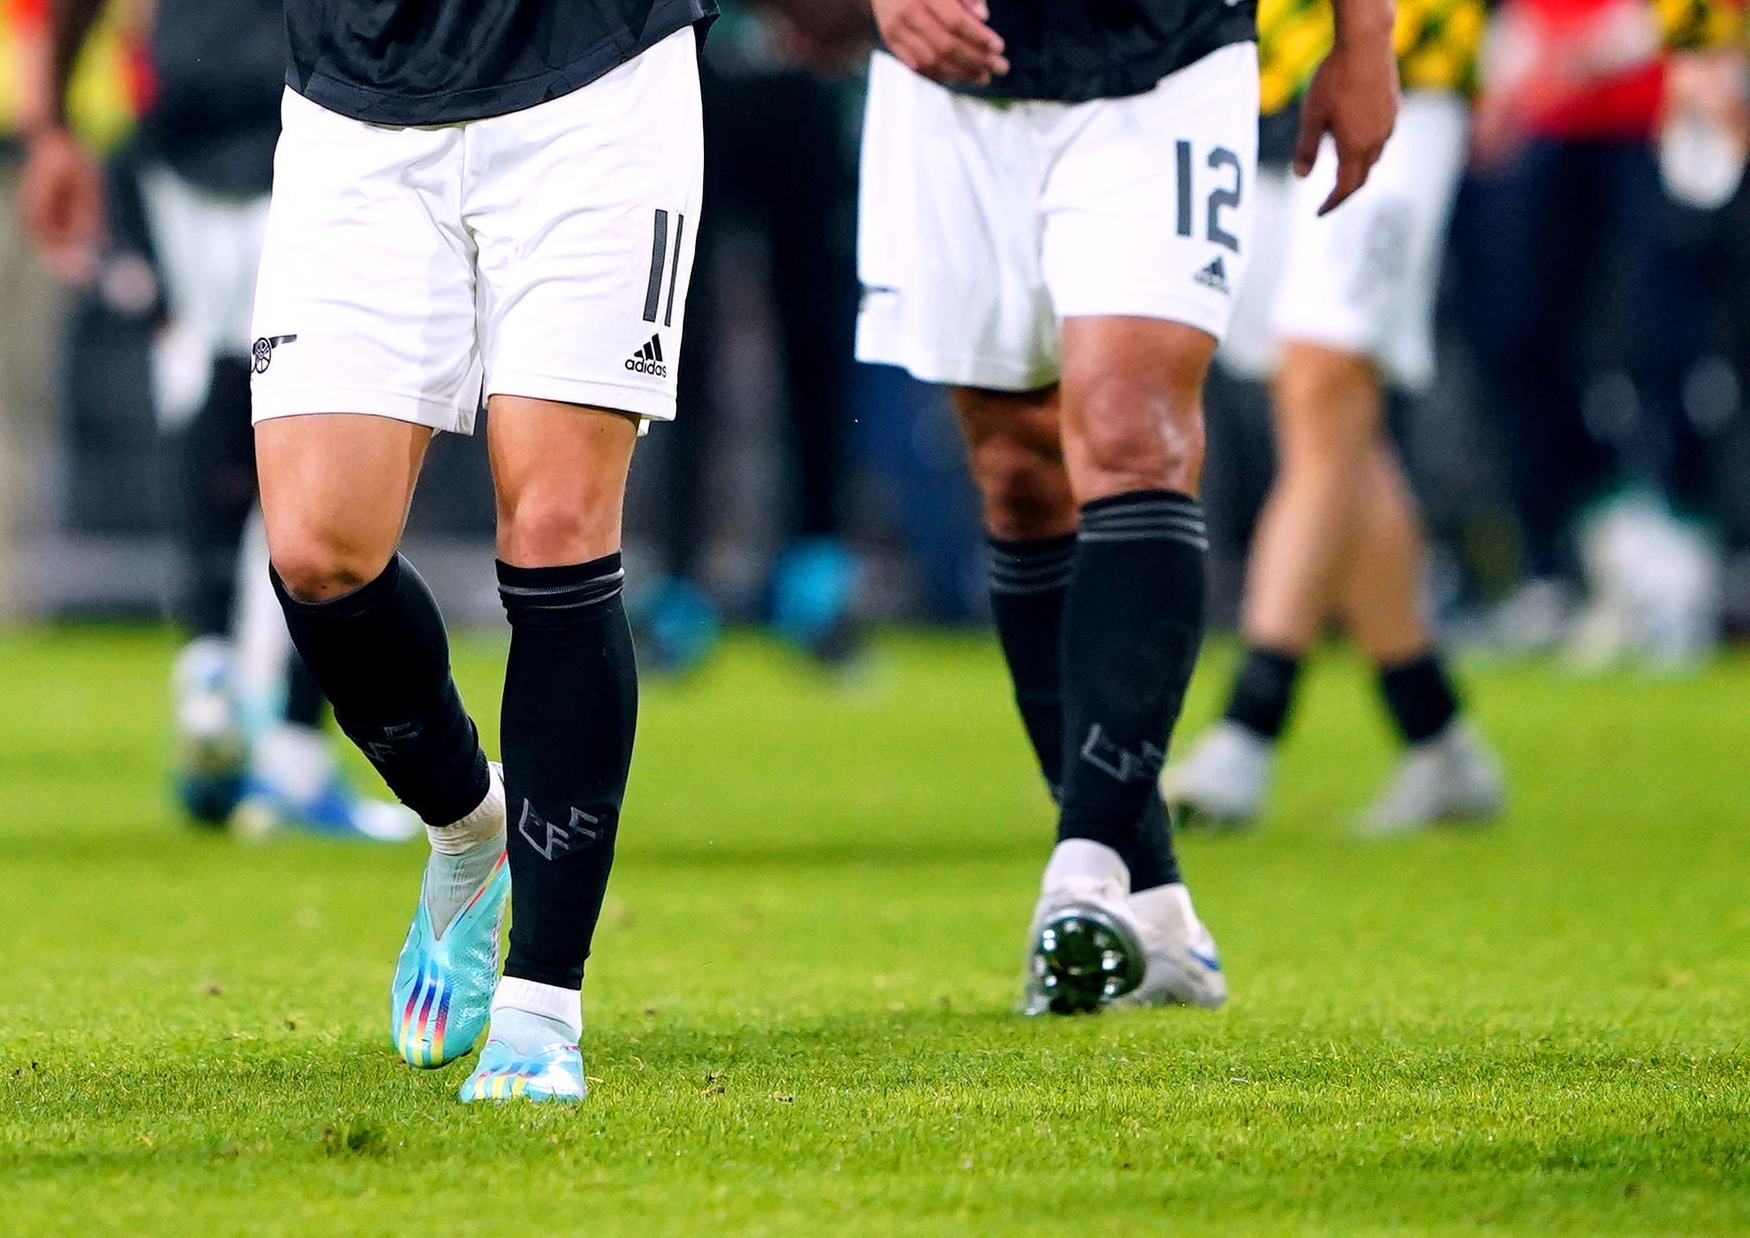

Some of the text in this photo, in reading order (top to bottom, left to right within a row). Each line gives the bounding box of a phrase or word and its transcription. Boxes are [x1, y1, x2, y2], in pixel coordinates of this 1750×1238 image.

[1175, 140, 1242, 253] 12
[643, 209, 684, 327] 11
[624, 357, 667, 378] adidas
